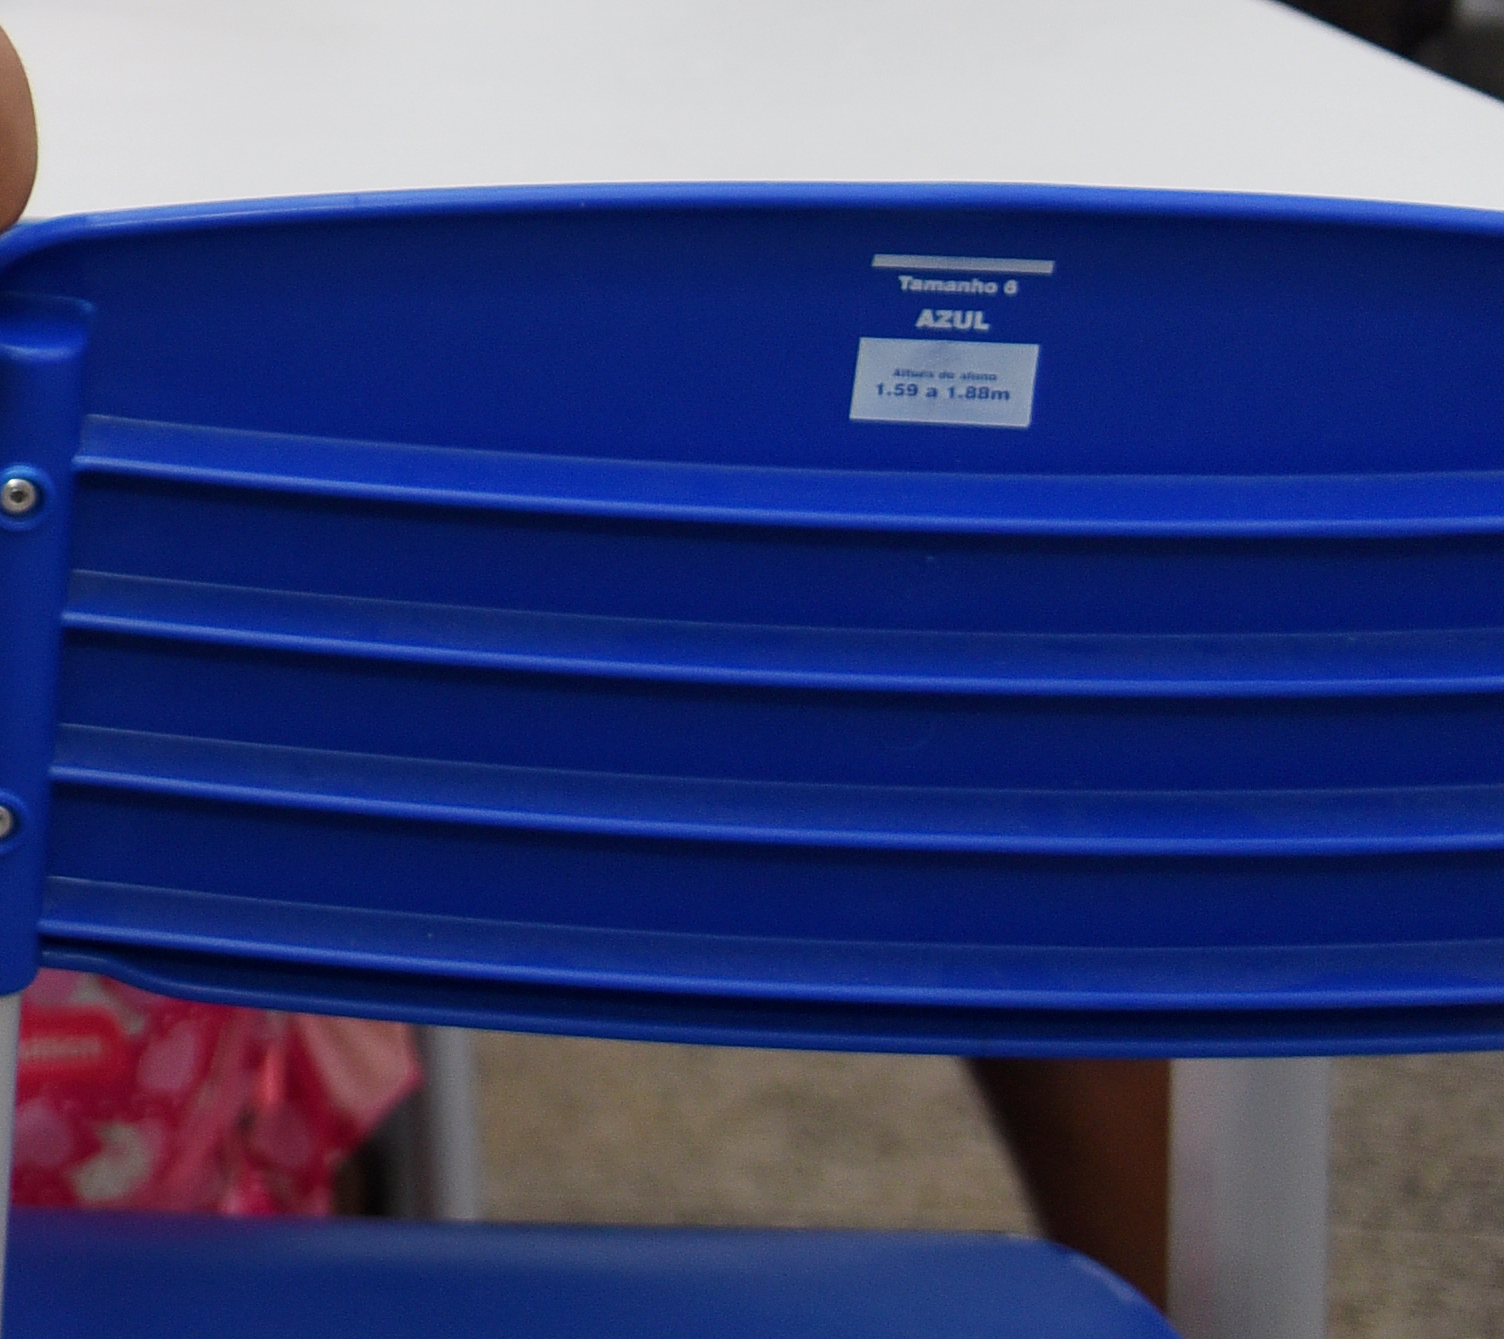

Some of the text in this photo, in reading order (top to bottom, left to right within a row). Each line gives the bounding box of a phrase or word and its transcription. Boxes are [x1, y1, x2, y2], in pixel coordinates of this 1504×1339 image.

[898, 275, 1019, 295] Tamanho 6
[915, 308, 990, 331] AZUL
[876, 383, 1010, 401] 1.59 a 1.88m
